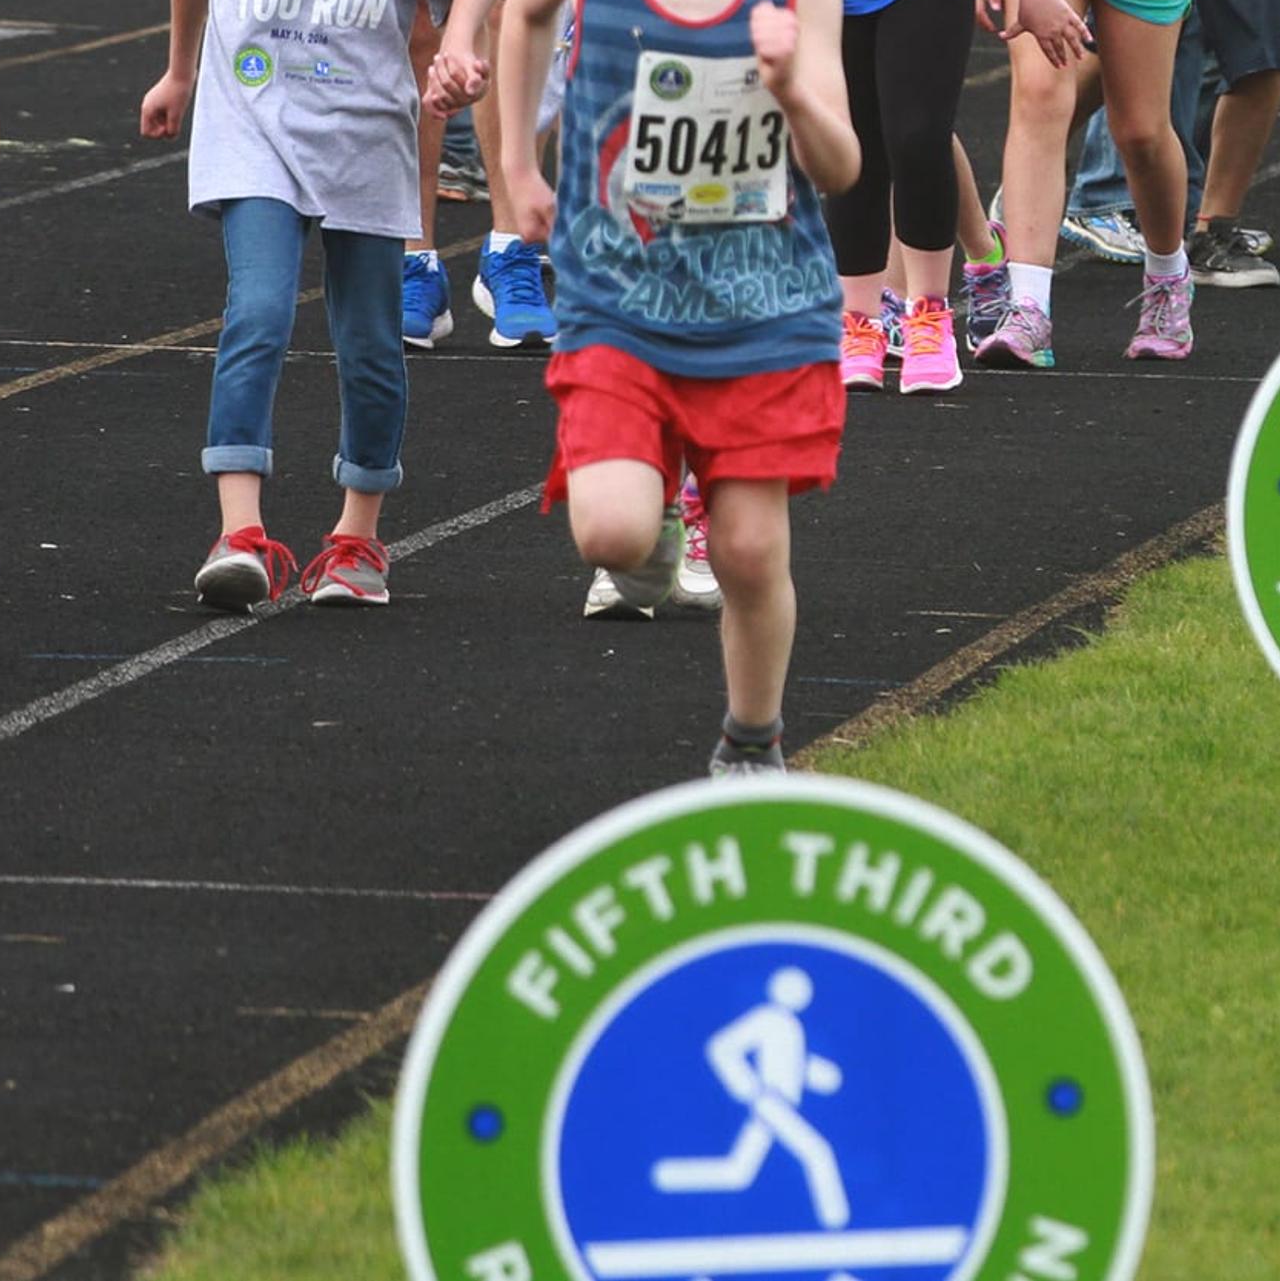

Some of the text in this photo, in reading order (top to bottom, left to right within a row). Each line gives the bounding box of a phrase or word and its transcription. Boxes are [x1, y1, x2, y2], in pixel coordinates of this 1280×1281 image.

[271, 28, 291, 40] MAY
[634, 111, 786, 176] 50413
[570, 210, 794, 283] CAPTAIN
[620, 259, 832, 323] AMERICA
[506, 831, 1034, 1020] FIFTH THIRD
